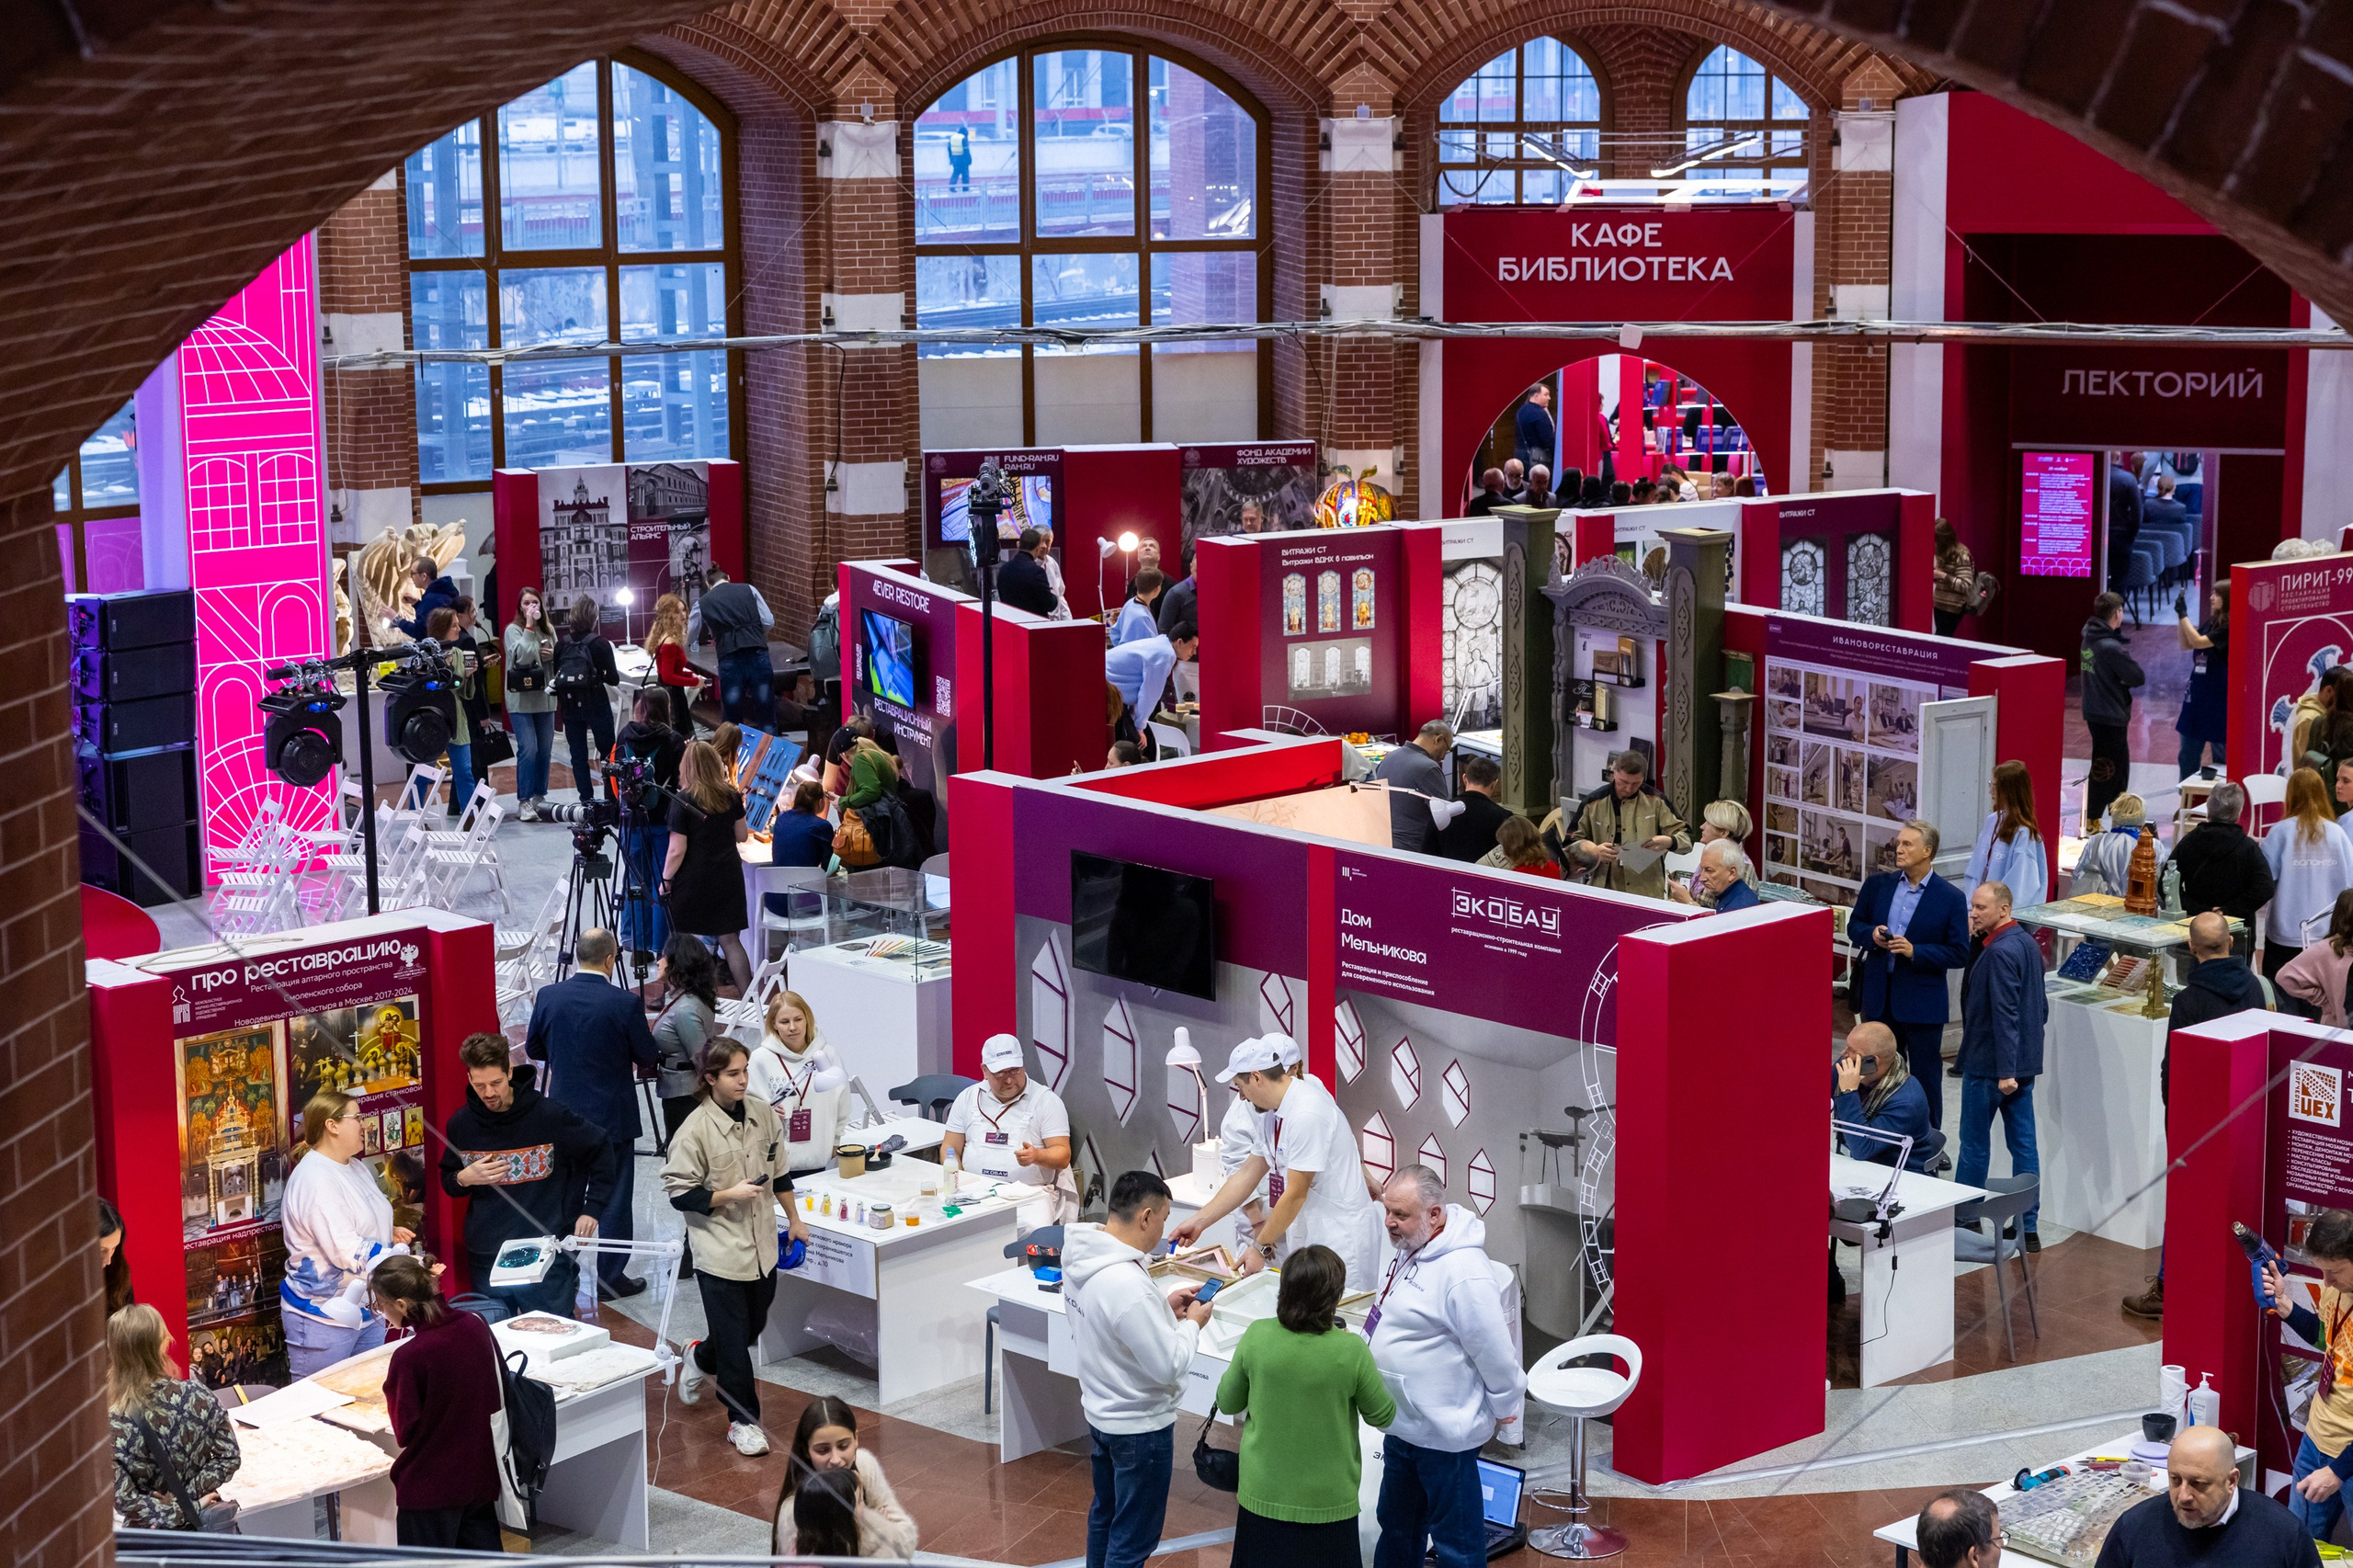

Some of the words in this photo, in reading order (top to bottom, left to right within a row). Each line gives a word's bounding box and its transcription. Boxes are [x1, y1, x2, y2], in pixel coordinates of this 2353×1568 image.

[1572, 222, 1663, 247] КАФЕ
[1498, 256, 1734, 282] БИБЛИОТЕКА
[2062, 368, 2263, 398] ЛЕКТОРИЙ
[1236, 449, 1262, 457] ФОНД
[1265, 448, 1311, 456] АКАДЕМИИ
[1237, 456, 1287, 465] ХУДОЖЕСТВ
[1779, 510, 1807, 518] ВИТРАЖИ
[630, 522, 691, 534] СТРОИТЕЛЬНЫЙ
[631, 532, 661, 540] АЛЬЯНС
[1281, 547, 1316, 556] ВИТРАЖИ
[1281, 558, 1313, 566] Витражи
[1314, 556, 1334, 564] ВДНХ
[1341, 553, 1374, 562] павильон
[2281, 567, 2353, 592] ПИРИТ-99
[872, 579, 894, 600] 4EVER
[895, 587, 930, 613] RESTORE
[1832, 635, 1938, 660] ИВАНОВОРЕСТАВРАЦИЯ
[874, 697, 932, 733] РЕСТАВРАЦИОННЫЙ
[893, 721, 932, 748] ИНСТРУМЕНТ
[1341, 908, 1371, 928] Дом
[1455, 895, 1557, 930] ЭКОБАУ
[1450, 926, 1533, 949] реставрационно-строительная
[1534, 944, 1562, 954] компания
[1341, 933, 1427, 965] Мельникова
[191, 971, 238, 993] про
[244, 938, 402, 986] реставрацию
[301, 971, 341, 987] алтарного
[341, 961, 393, 979] пространства
[1341, 960, 1377, 974] Реставрация
[1381, 971, 1428, 986] приспособление
[1353, 972, 1392, 986] современного
[1392, 982, 1435, 995] использования
[283, 987, 335, 1003] Смоленского
[335, 982, 363, 994] собора
[234, 1010, 294, 1028] Новодевичьего
[295, 1002, 337, 1017] монастыря
[345, 994, 373, 1007] Москве
[374, 986, 414, 1002] 2017-2024
[356, 1094, 384, 1105] врация
[384, 1085, 423, 1098] станковой
[380, 1102, 417, 1116] живописи
[2301, 1096, 2336, 1120] ЦЕХ
[2291, 1130, 2336, 1142] ХУДОЖЕСТВЕННАЯ
[2291, 1135, 2325, 1146] РЕСТАВРАЦИЯ
[2325, 1142, 2350, 1152] МОЗАИКИ
[2290, 1147, 2325, 1159] ПЕРЕНЕСЕНИЕ
[2325, 1154, 2350, 1165] МОЗАИКИ
[2291, 1141, 2314, 1151] МОНТАЖ,
[2314, 1146, 2343, 1156] ДЕМОНТАЖ
[2290, 1153, 2332, 1166] МАСТЕР-КЛАССЫ
[2290, 1159, 2341, 1174] КОНСУЛЬТИРОВАНИЕ
[2286, 1170, 2317, 1181] МОЗАИЧНЫХ
[2317, 1176, 2336, 1185] ПАННО
[2290, 1165, 2330, 1178] ОБСЛЕДОВАНИЕ
[2286, 1181, 2328, 1195] ОРГАНИЗАЦИЯМИ
[2290, 1176, 2334, 1190] СОТРУДНИЧЕСТВО
[232, 1222, 282, 1238] надпрестоль
[814, 1244, 853, 1257] сохранившегося
[832, 1239, 852, 1249] мрамора
[815, 1250, 845, 1264] Мельникова
[1188, 1370, 1209, 1381] ьникова
